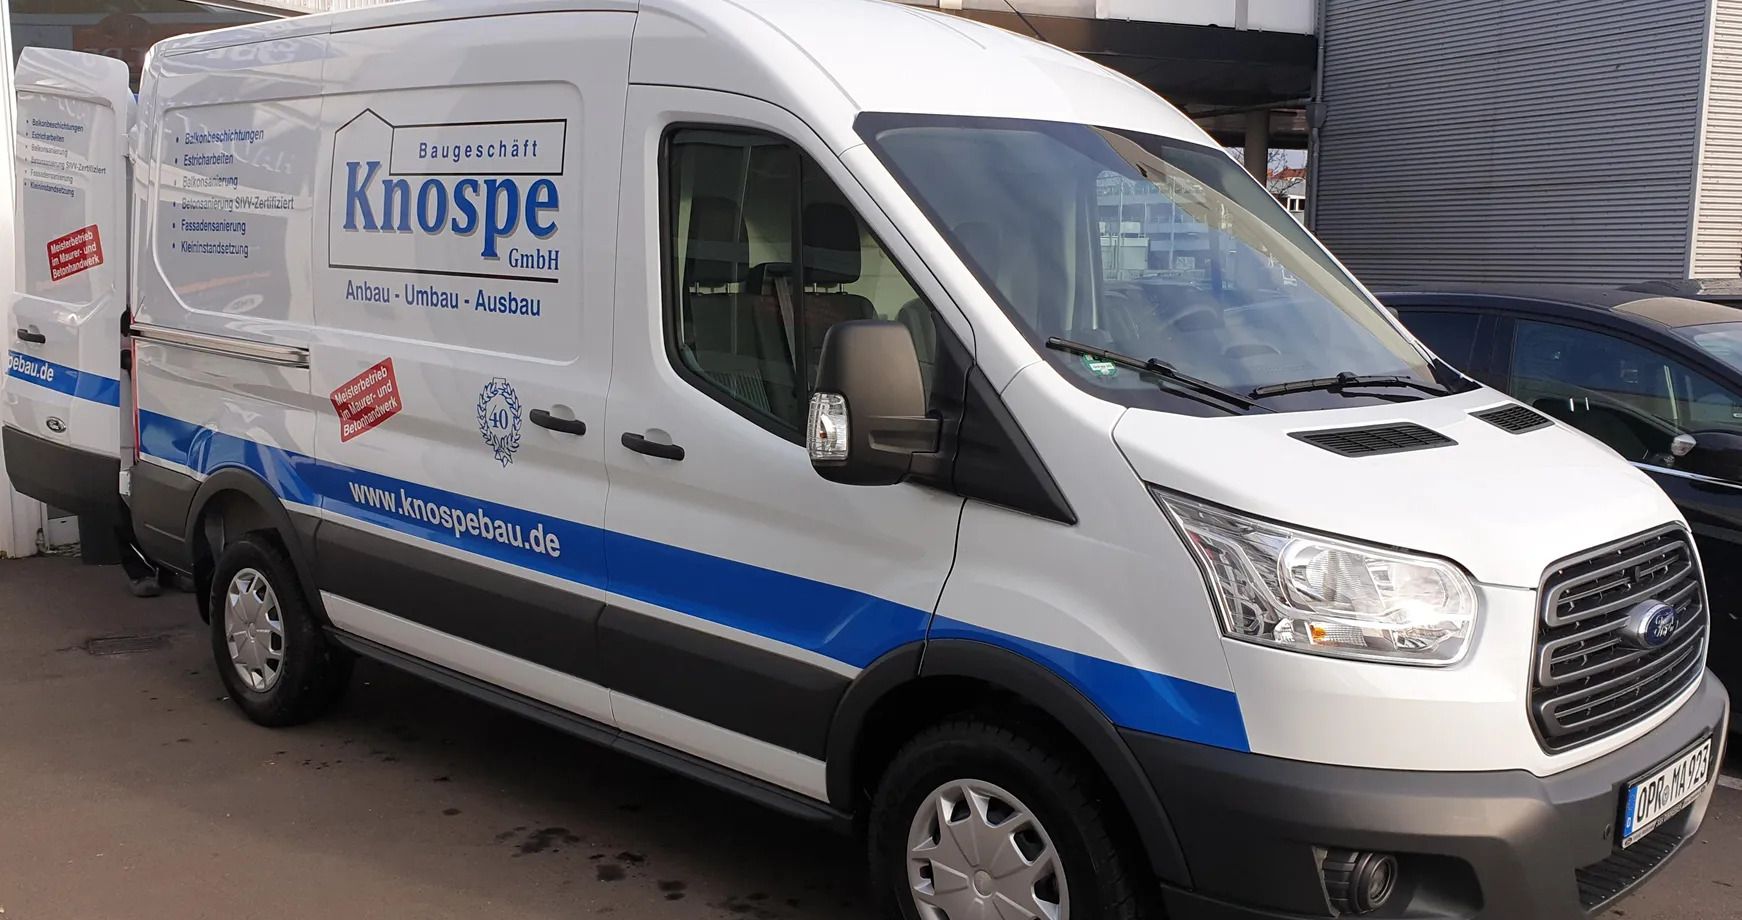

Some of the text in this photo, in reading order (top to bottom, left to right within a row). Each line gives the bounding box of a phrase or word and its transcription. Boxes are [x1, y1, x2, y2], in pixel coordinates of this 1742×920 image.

[184, 129, 264, 144] Balkonbeschichtungen
[183, 153, 234, 166] Estricharbeiten
[419, 139, 538, 162] Baugeschäft
[182, 175, 238, 189] Balkonsanierung
[181, 197, 233, 212] Betonsanierung
[343, 161, 559, 260] Knospe
[181, 219, 246, 235] Fassadensanierung
[50, 230, 94, 253] Meisterbetrieb
[51, 241, 97, 266] im Maurer- und
[181, 241, 249, 258] Kleininstandsetzung
[52, 254, 100, 279] Betonhandwerk
[508, 248, 559, 270] GmbH
[346, 280, 390, 303] Anbau
[404, 283, 459, 309] Umbau
[475, 289, 541, 316] Ausbau
[335, 366, 388, 405] Meisterbetrieb
[340, 379, 392, 420] im Maurer- und
[343, 396, 398, 436] Betonhandwerk
[489, 405, 508, 430] 40
[349, 481, 560, 558] www.knospebau.de
[1636, 774, 1665, 823] OPR
[1670, 760, 1687, 802] MA
[1687, 744, 1708, 790] 923
